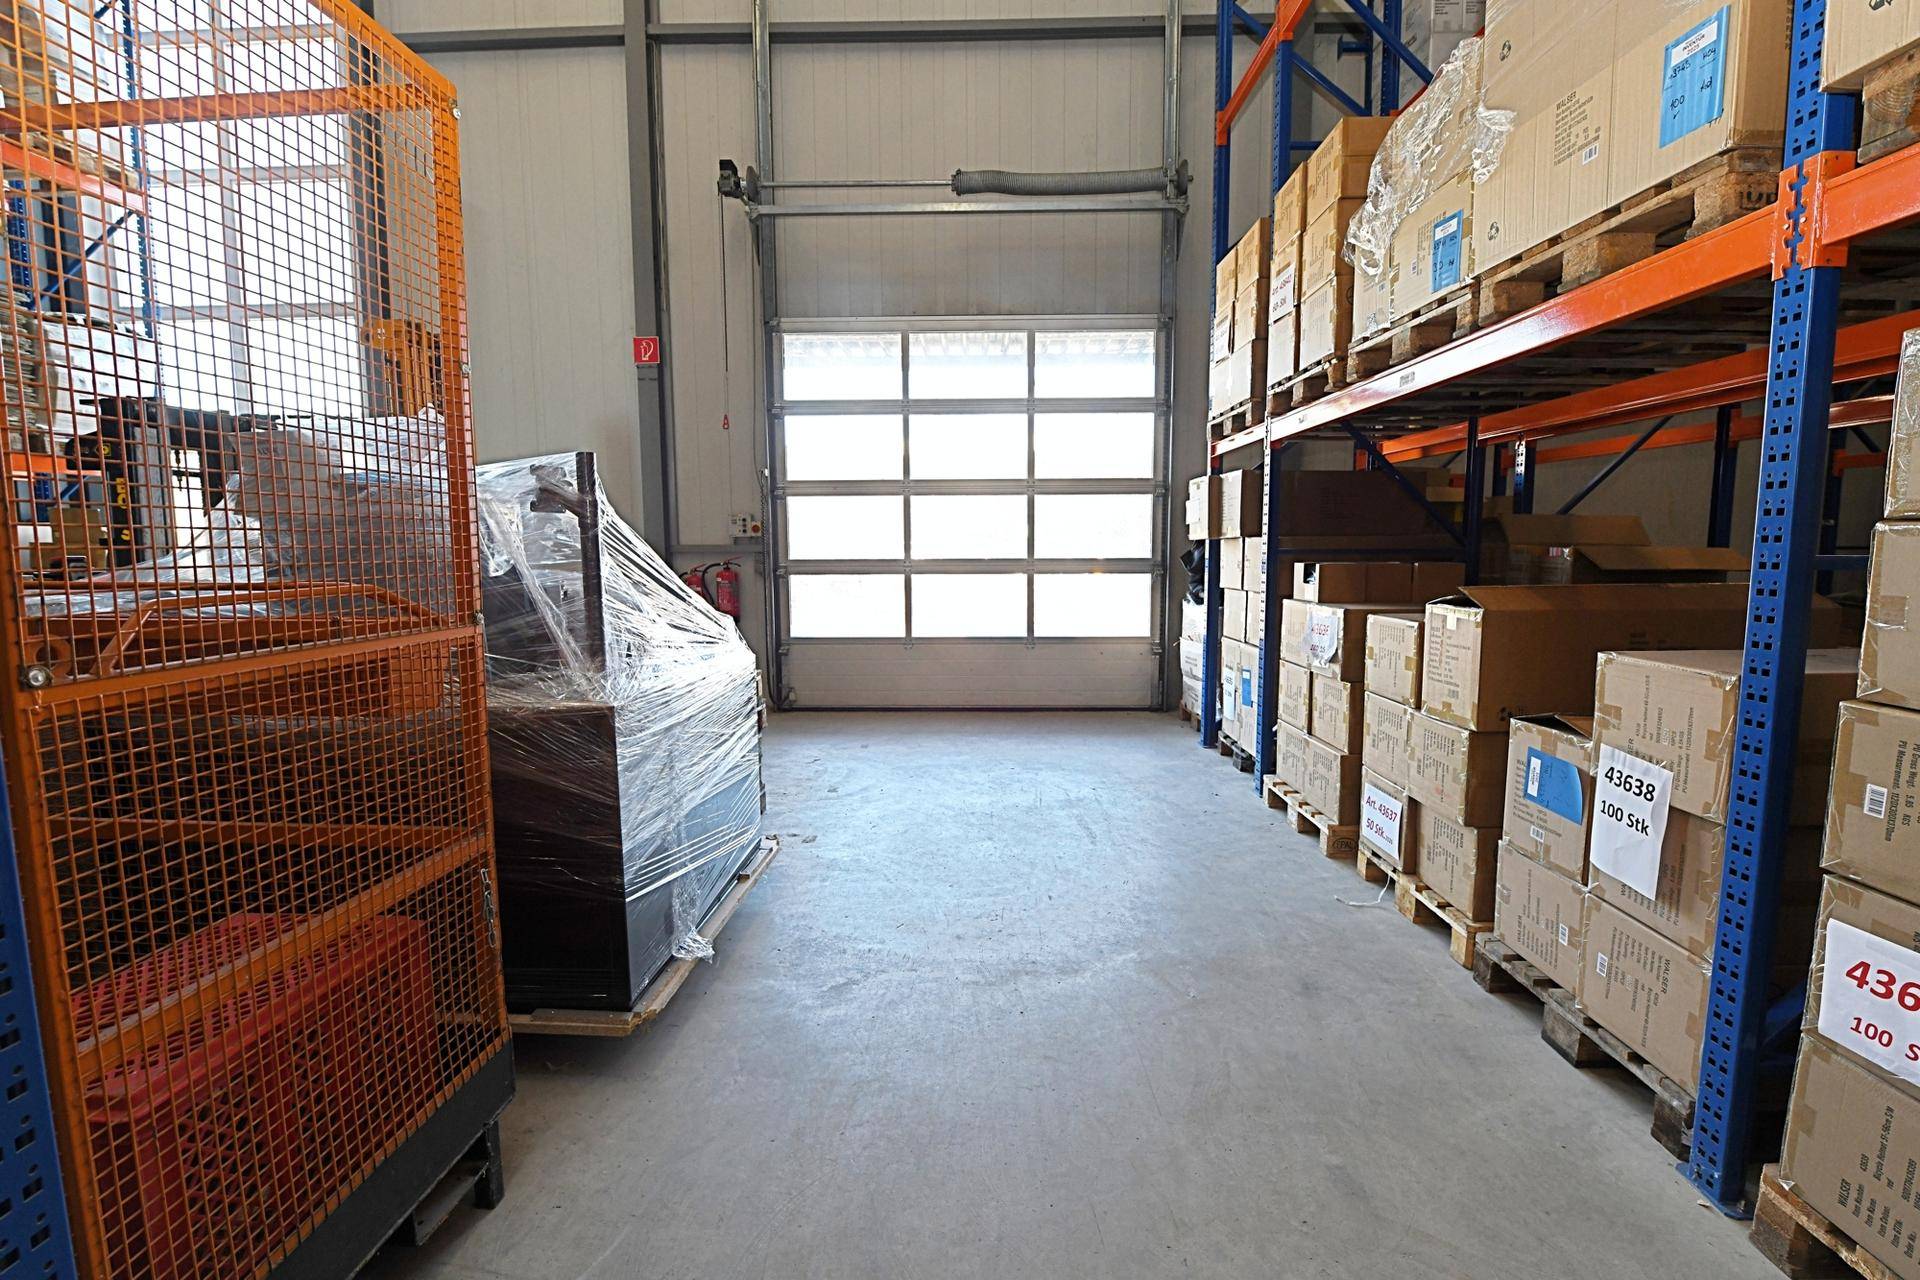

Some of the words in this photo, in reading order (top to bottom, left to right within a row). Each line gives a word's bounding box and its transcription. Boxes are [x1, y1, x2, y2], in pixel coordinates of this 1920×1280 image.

[1605, 766, 1656, 802] 43638
[1365, 795, 1377, 810] Art.
[1600, 799, 1624, 822] 100
[1626, 812, 1650, 837] Stk
[1366, 817, 1375, 831] 50
[1660, 958, 1671, 995] WALSER
[1850, 1016, 1894, 1048] 100
[1837, 1177, 1852, 1208] WALSER
